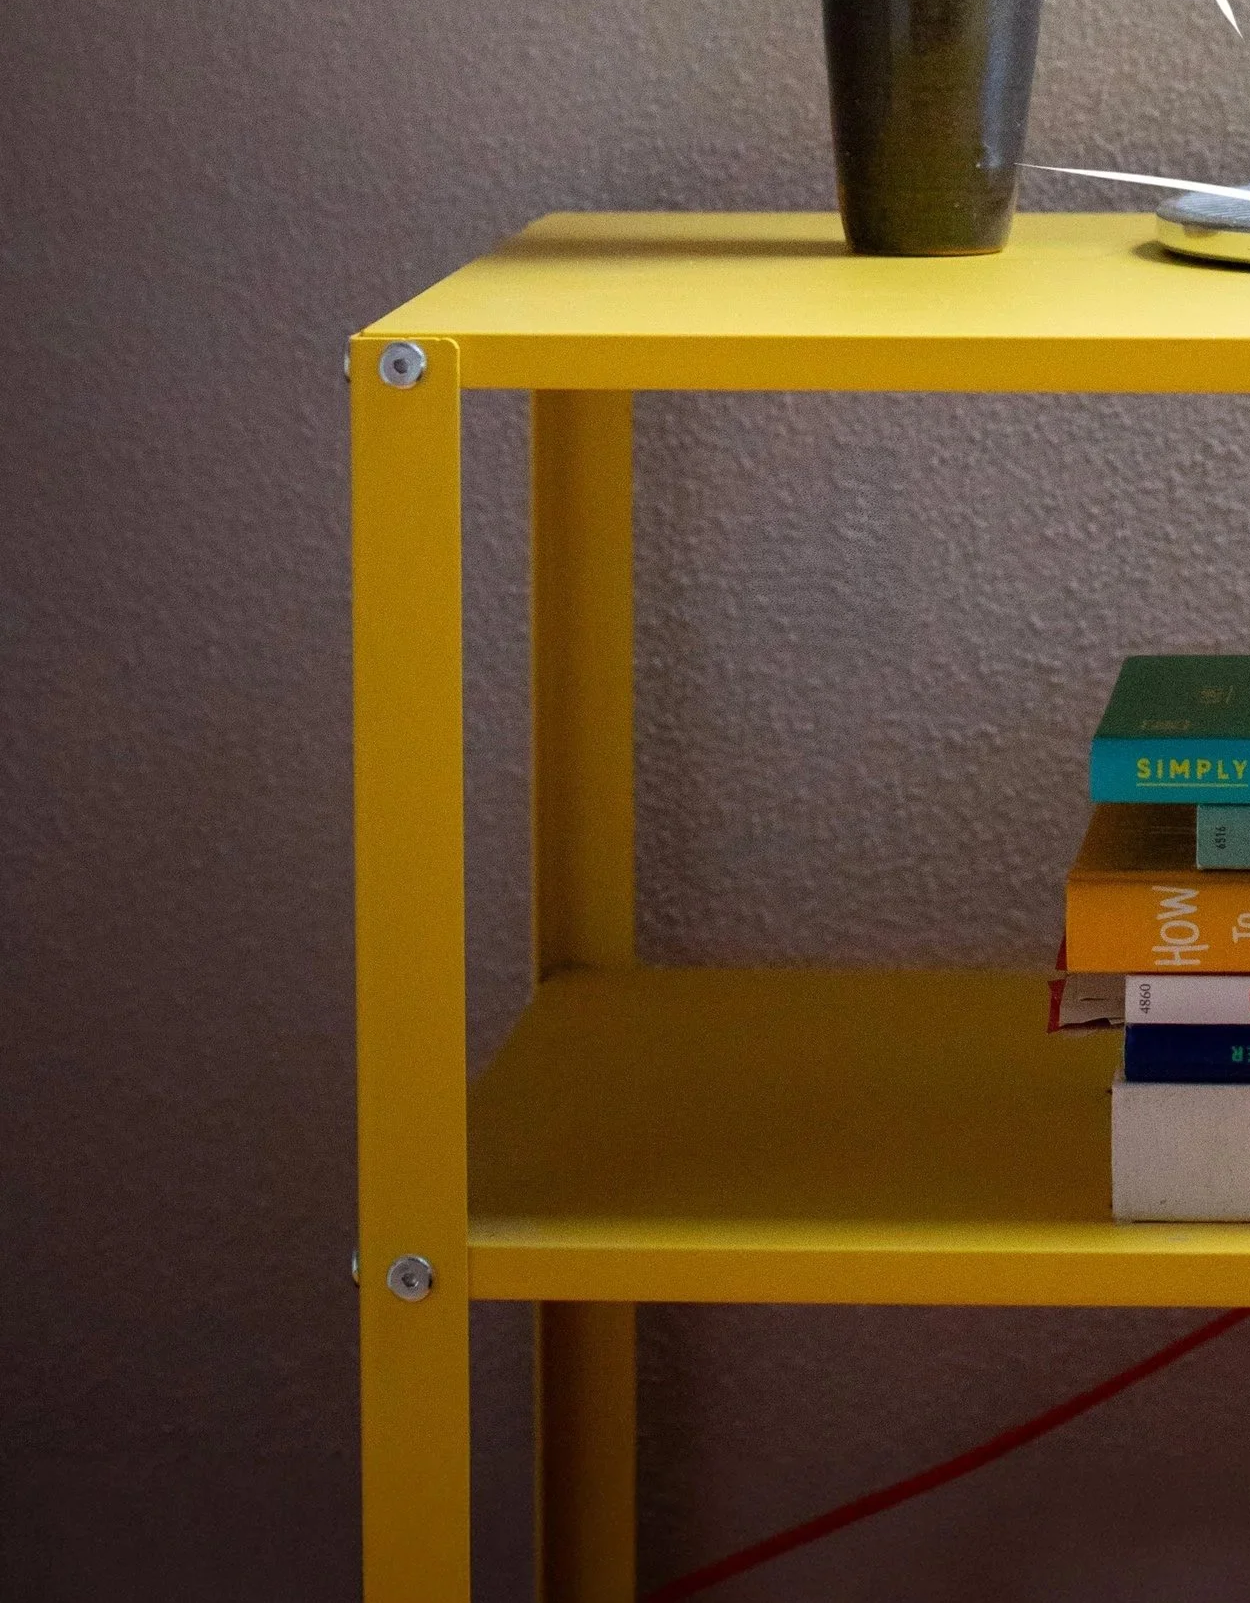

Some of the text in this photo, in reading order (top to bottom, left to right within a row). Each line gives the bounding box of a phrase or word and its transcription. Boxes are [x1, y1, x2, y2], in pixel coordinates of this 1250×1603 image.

[1136, 758, 1249, 781] SIMPLY
[1152, 885, 1210, 968] HOW
[1139, 983, 1152, 1014] 4860
